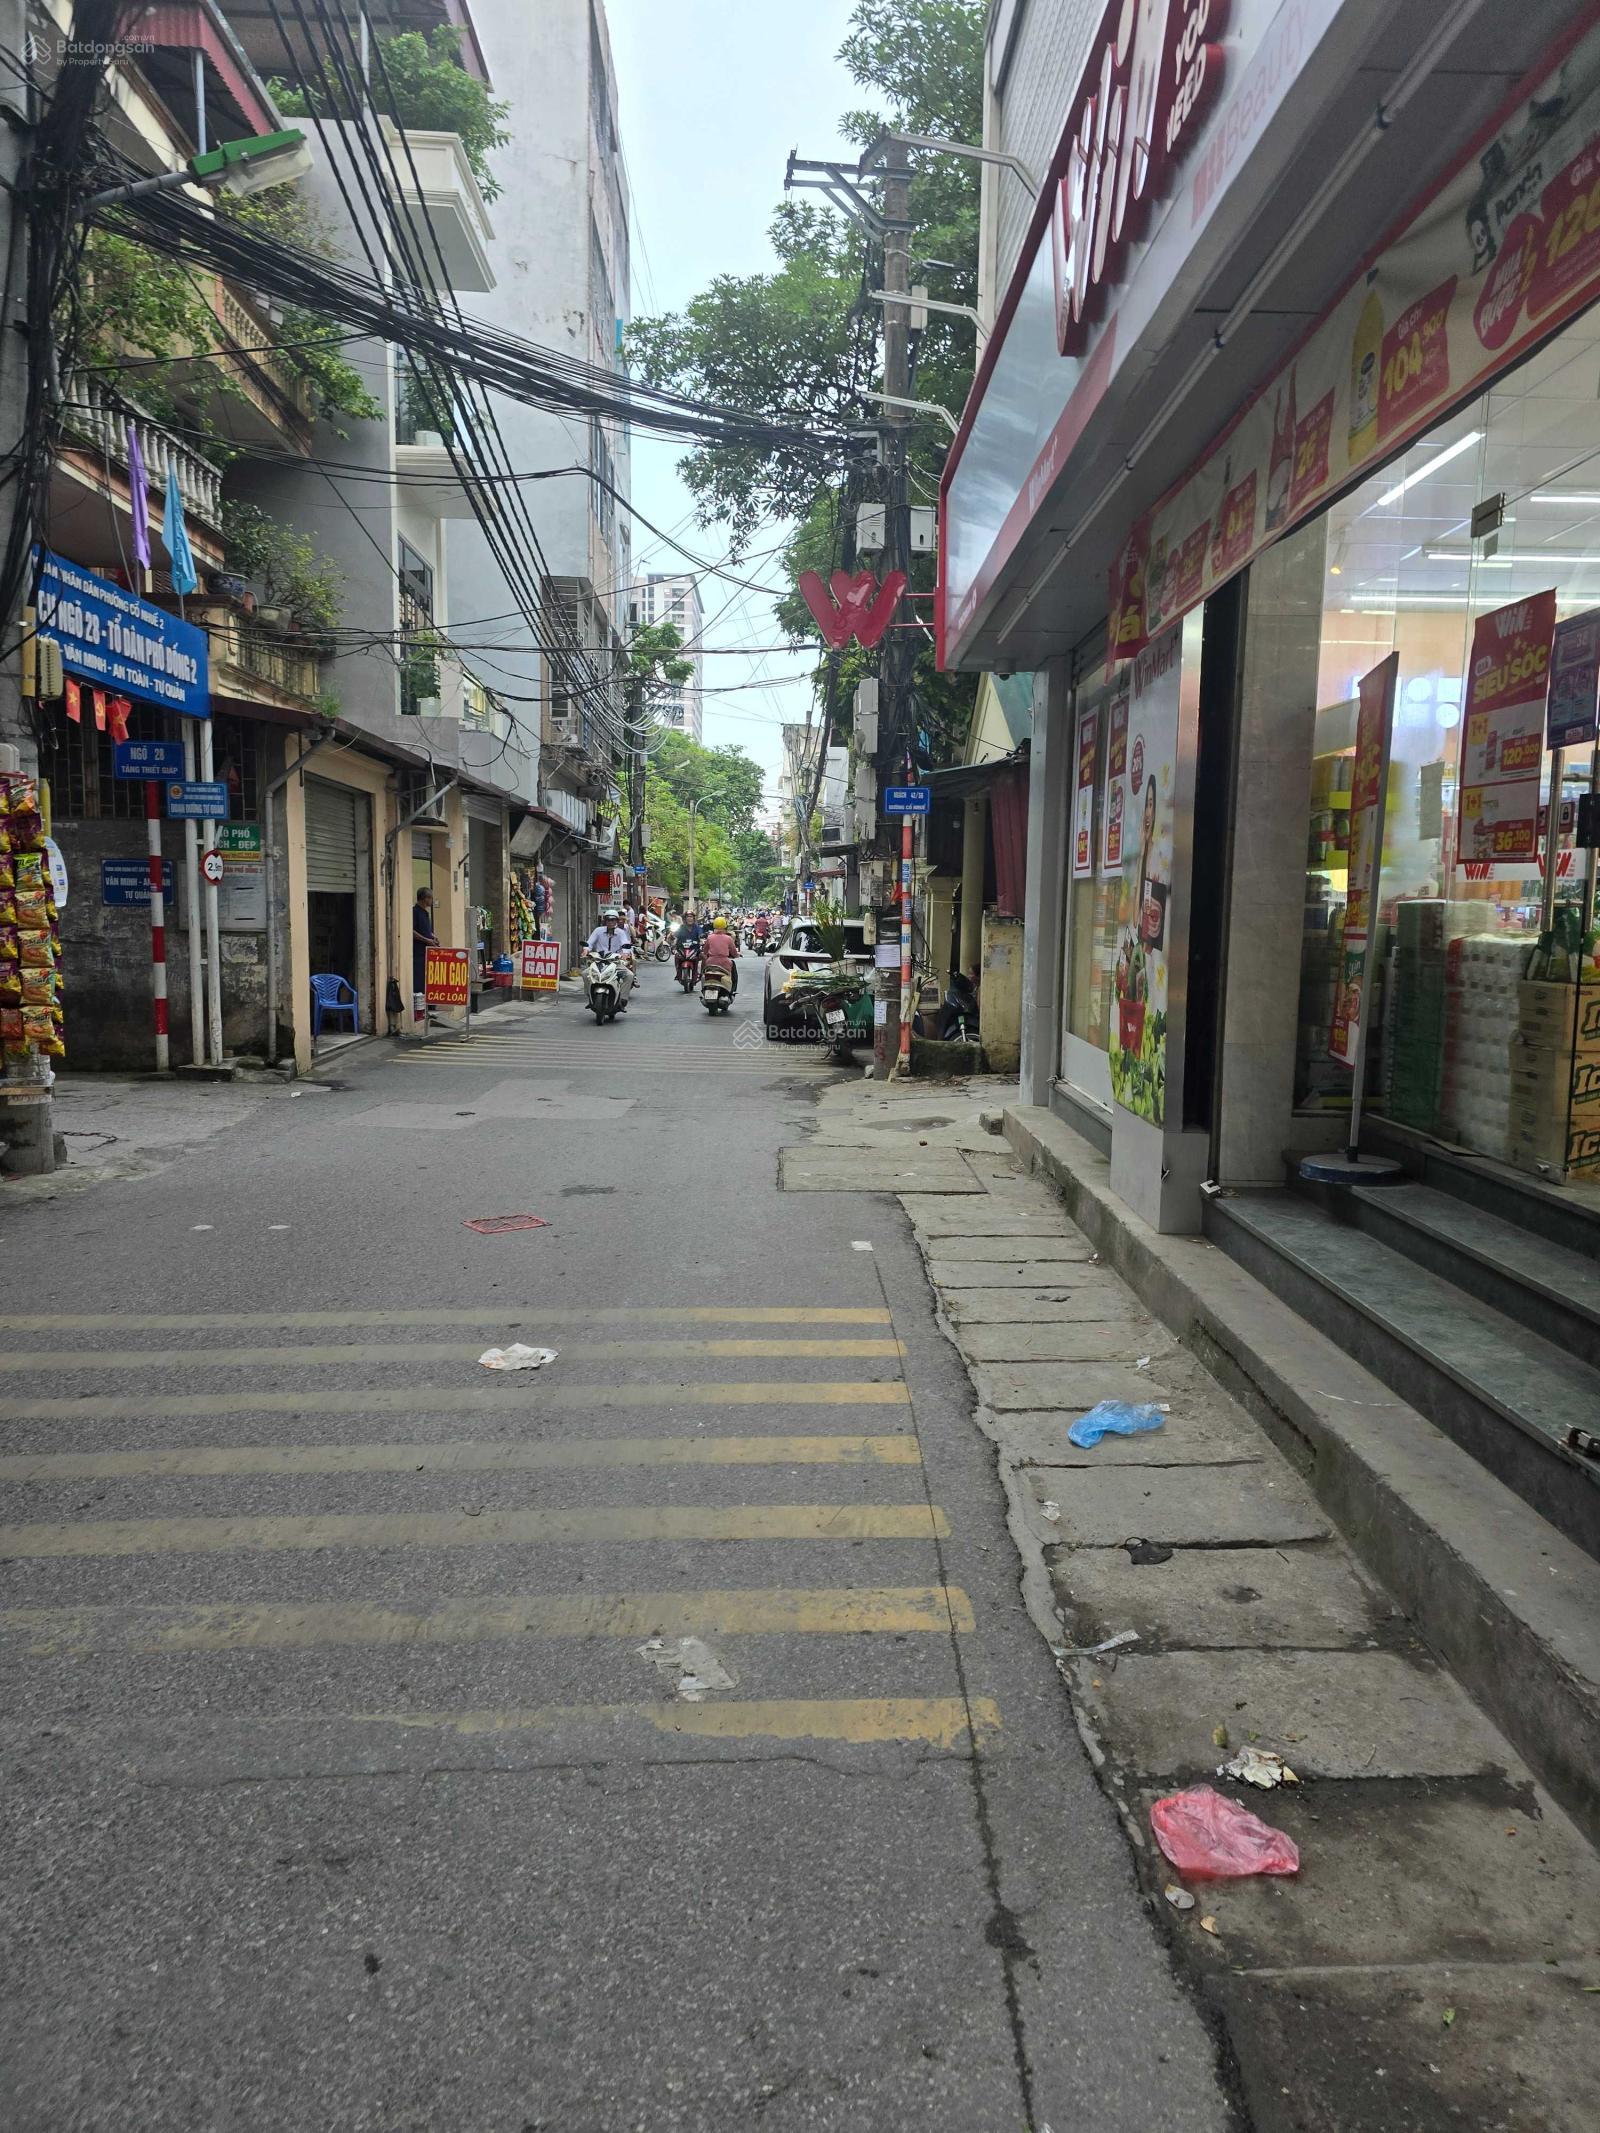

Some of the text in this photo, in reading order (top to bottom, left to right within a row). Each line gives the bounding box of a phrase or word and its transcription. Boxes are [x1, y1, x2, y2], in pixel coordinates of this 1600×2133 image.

[82, 580, 100, 599] DÂN
[129, 600, 140, 618] CỔ
[159, 618, 165, 630] 2
[57, 599, 84, 639] NGÕ
[85, 610, 100, 645] 28
[106, 613, 122, 653] TỔ
[123, 624, 146, 664] DÂN
[145, 635, 165, 671] PHỐ
[190, 657, 198, 685] 2
[83, 650, 107, 673] MINH
[112, 663, 126, 681] AN
[126, 667, 149, 689] TOÀN
[130, 745, 165, 761] NGÕ 28
[231, 826, 251, 839] PHỐ
[238, 840, 257, 850] ĐẸP
[525, 944, 558, 960] BÁN
[427, 956, 467, 991] BÁN GẠO
[525, 960, 557, 978] GẠO
[427, 990, 466, 1004] CÁC LOẠI
